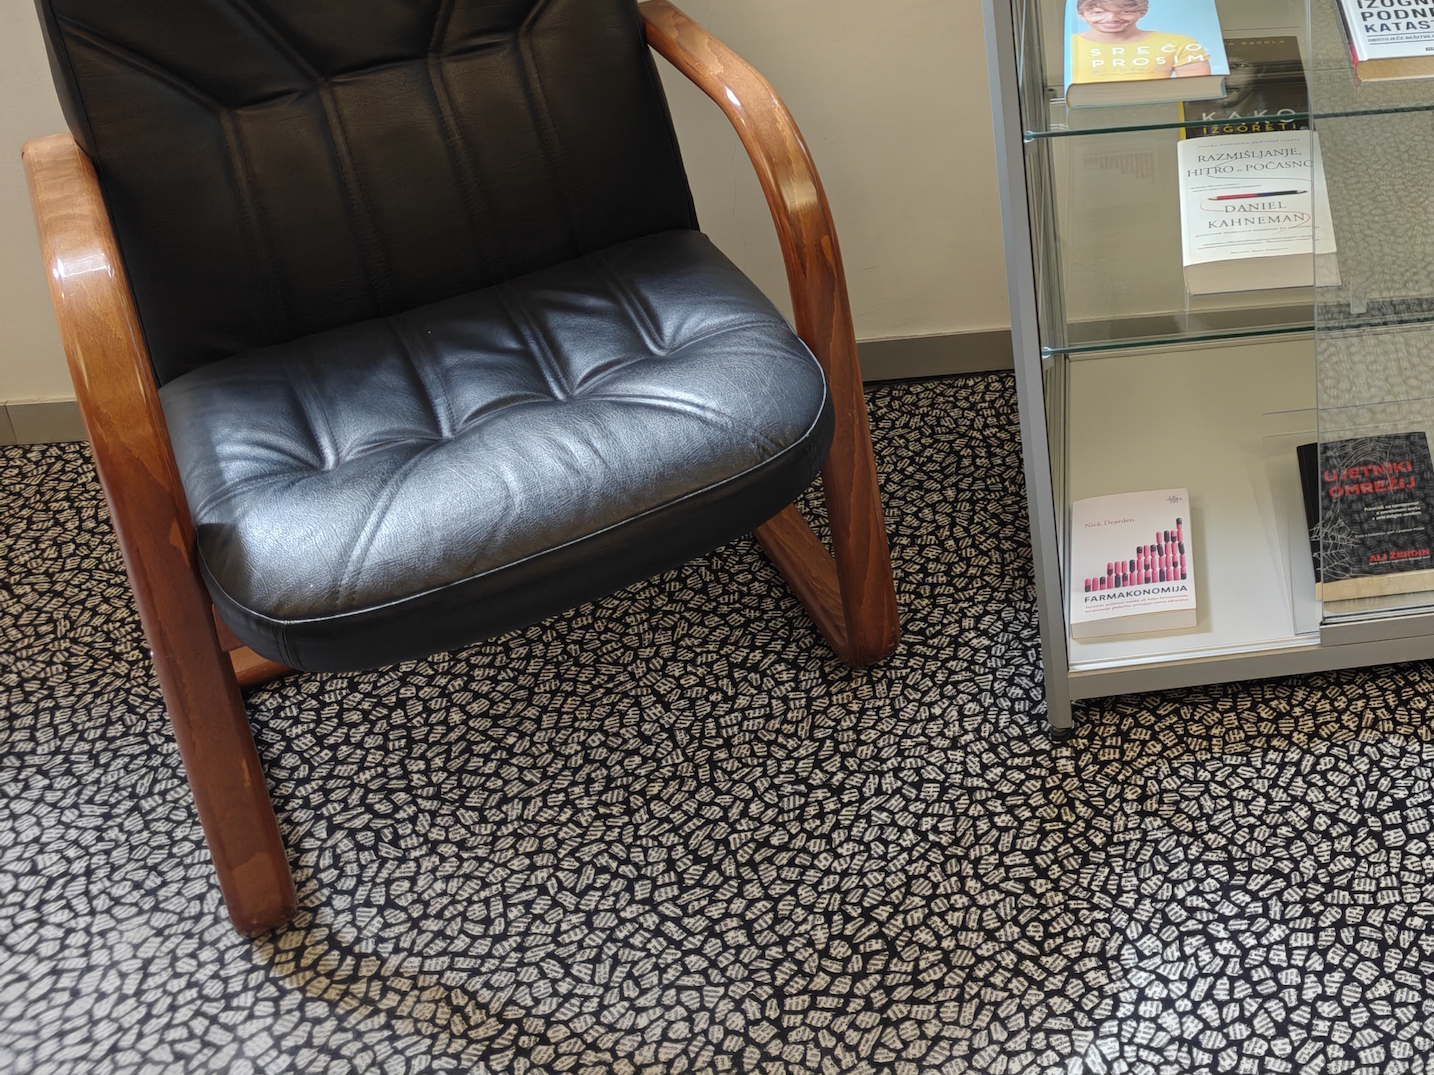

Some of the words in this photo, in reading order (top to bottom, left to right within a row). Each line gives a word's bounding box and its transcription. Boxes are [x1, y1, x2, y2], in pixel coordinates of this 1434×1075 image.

[1091, 54, 1205, 68] PROSIM
[1202, 108, 1297, 123] KAKO
[1202, 122, 1298, 135] IZGORETI
[1187, 165, 1234, 177] HITRO
[1245, 160, 1314, 172] POČASNO
[1225, 201, 1287, 213] DANIEL
[1208, 213, 1306, 229] KAHNEMAN
[1323, 460, 1413, 482] UJETNIKI
[1084, 521, 1102, 529] Nick
[1104, 518, 1135, 526] Dearden
[1084, 585, 1188, 603] FARMAKONOMIJA
